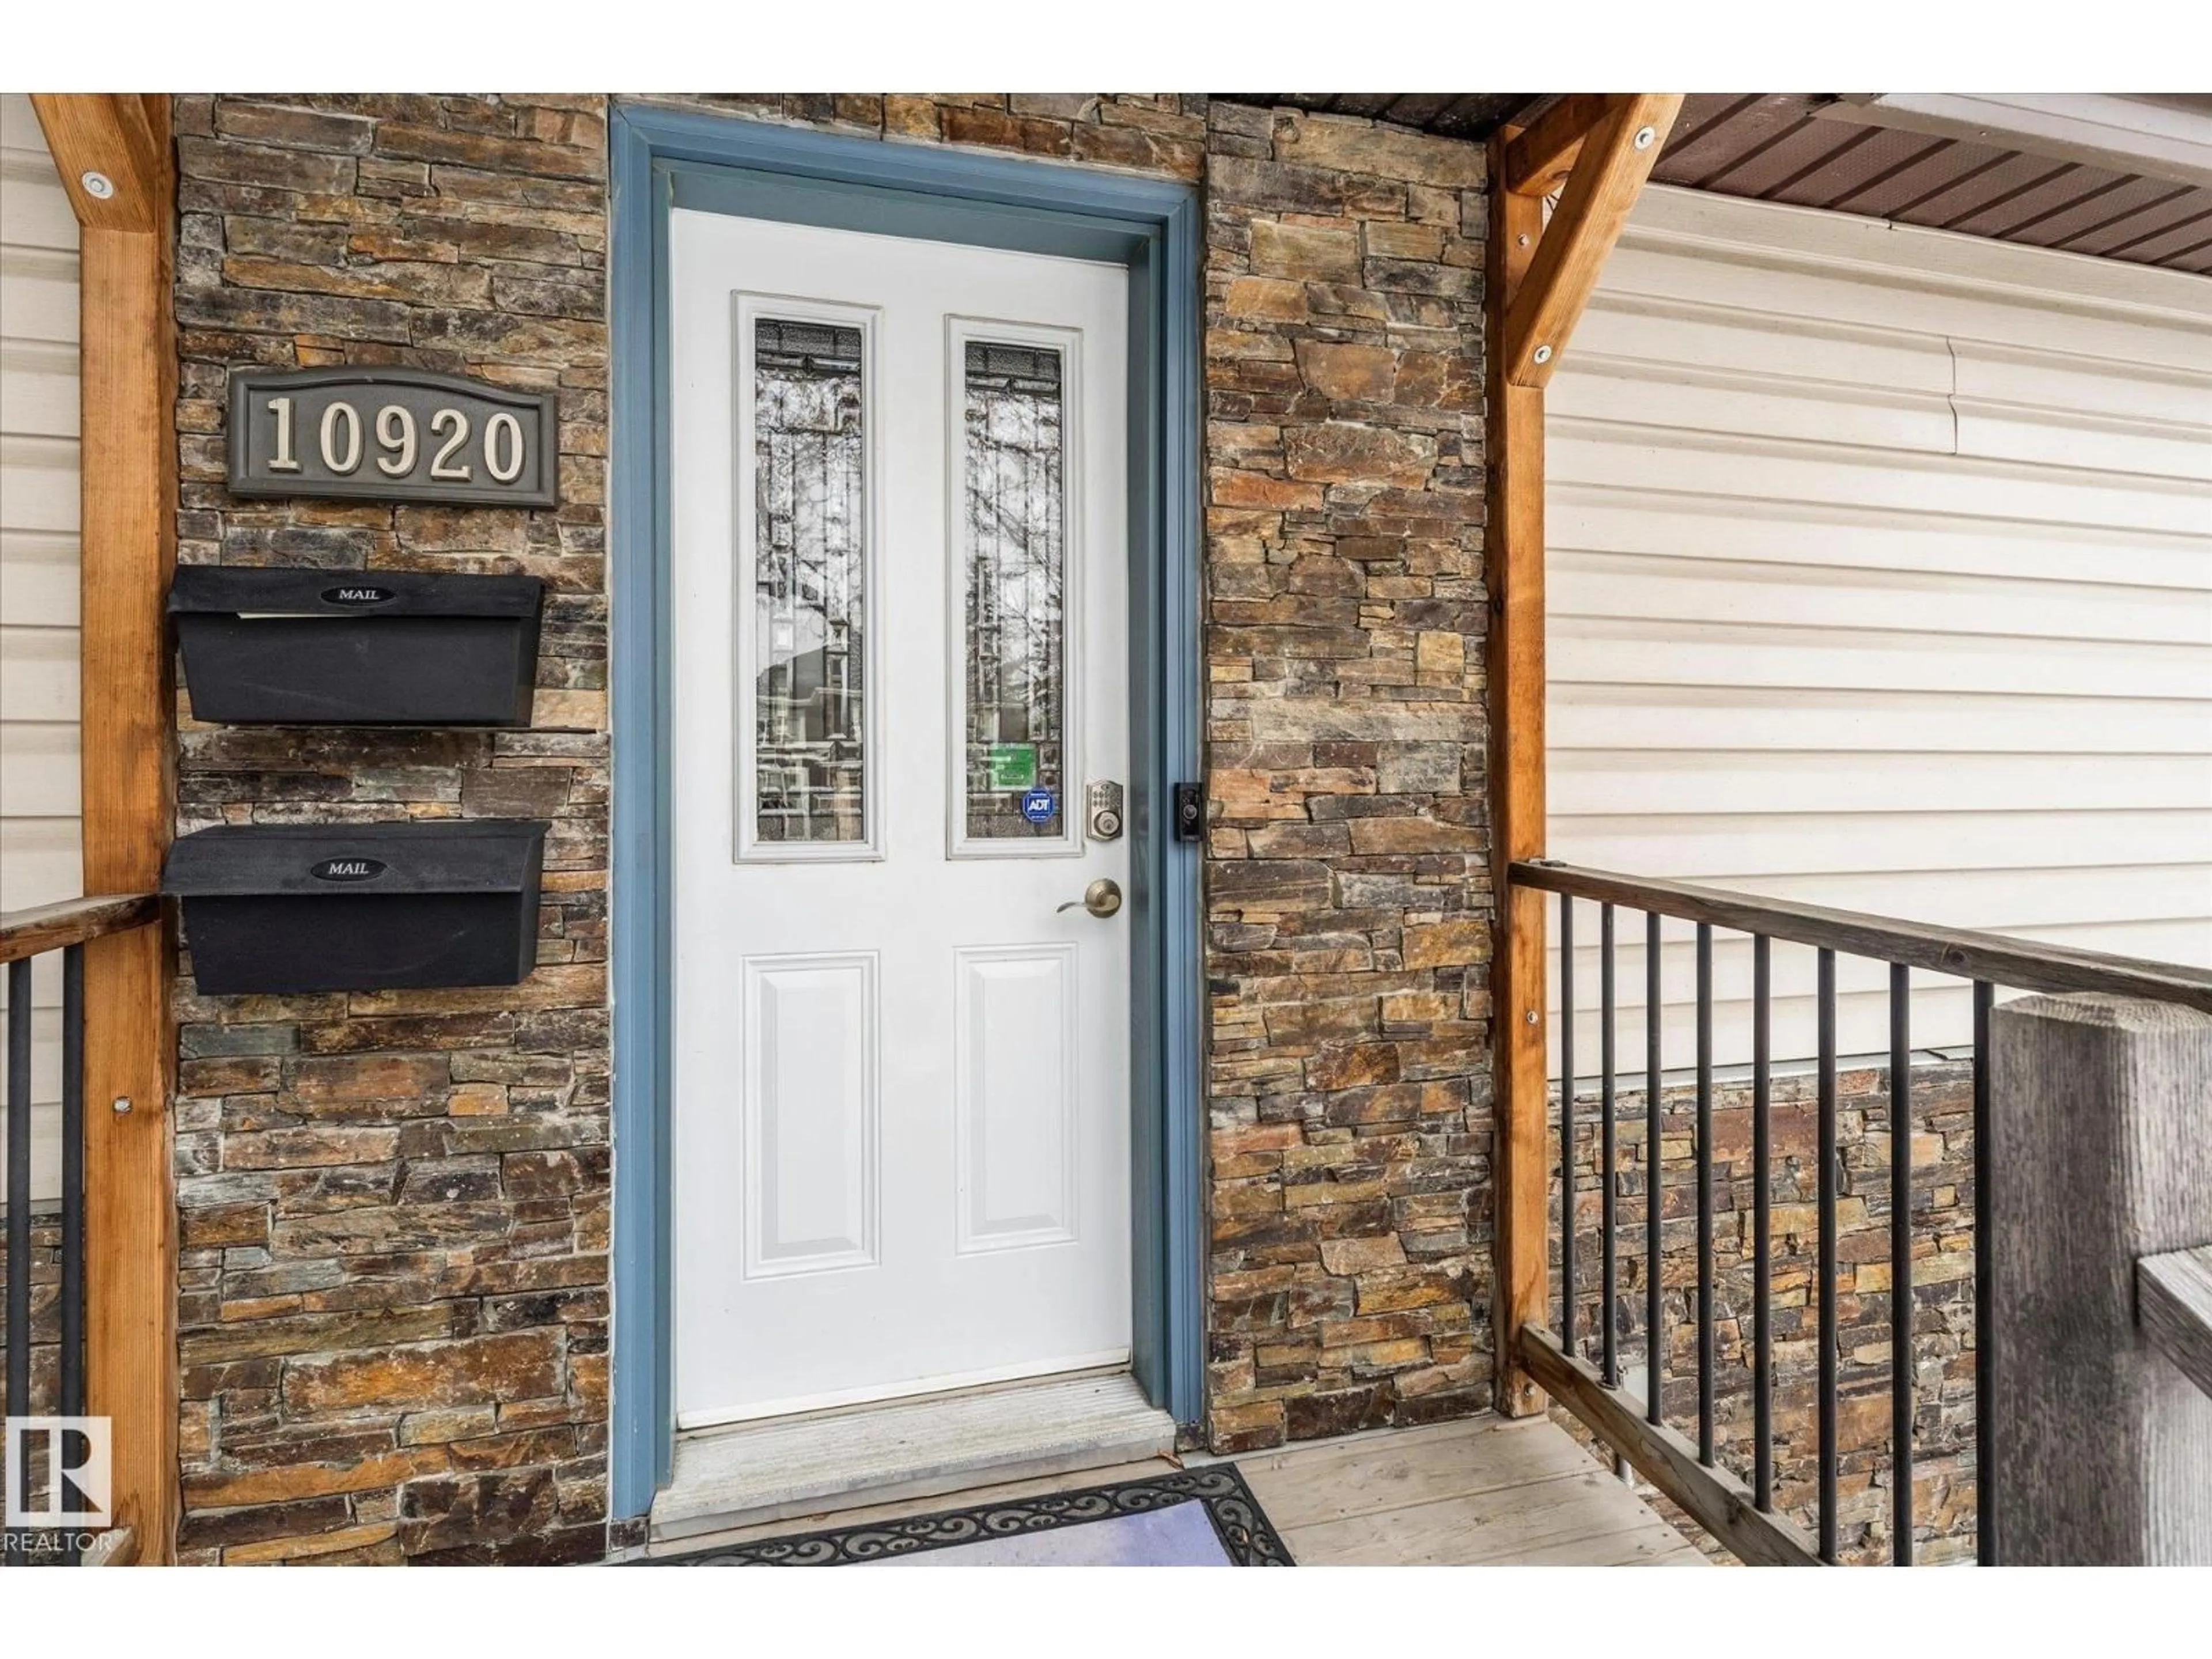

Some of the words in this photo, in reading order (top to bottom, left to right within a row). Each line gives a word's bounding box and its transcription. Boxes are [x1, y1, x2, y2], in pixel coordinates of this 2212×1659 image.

[268, 397, 524, 484] 10920
[339, 589, 380, 600] MAIL
[1028, 798, 1050, 811] ADT
[328, 862, 369, 874] MAIL
